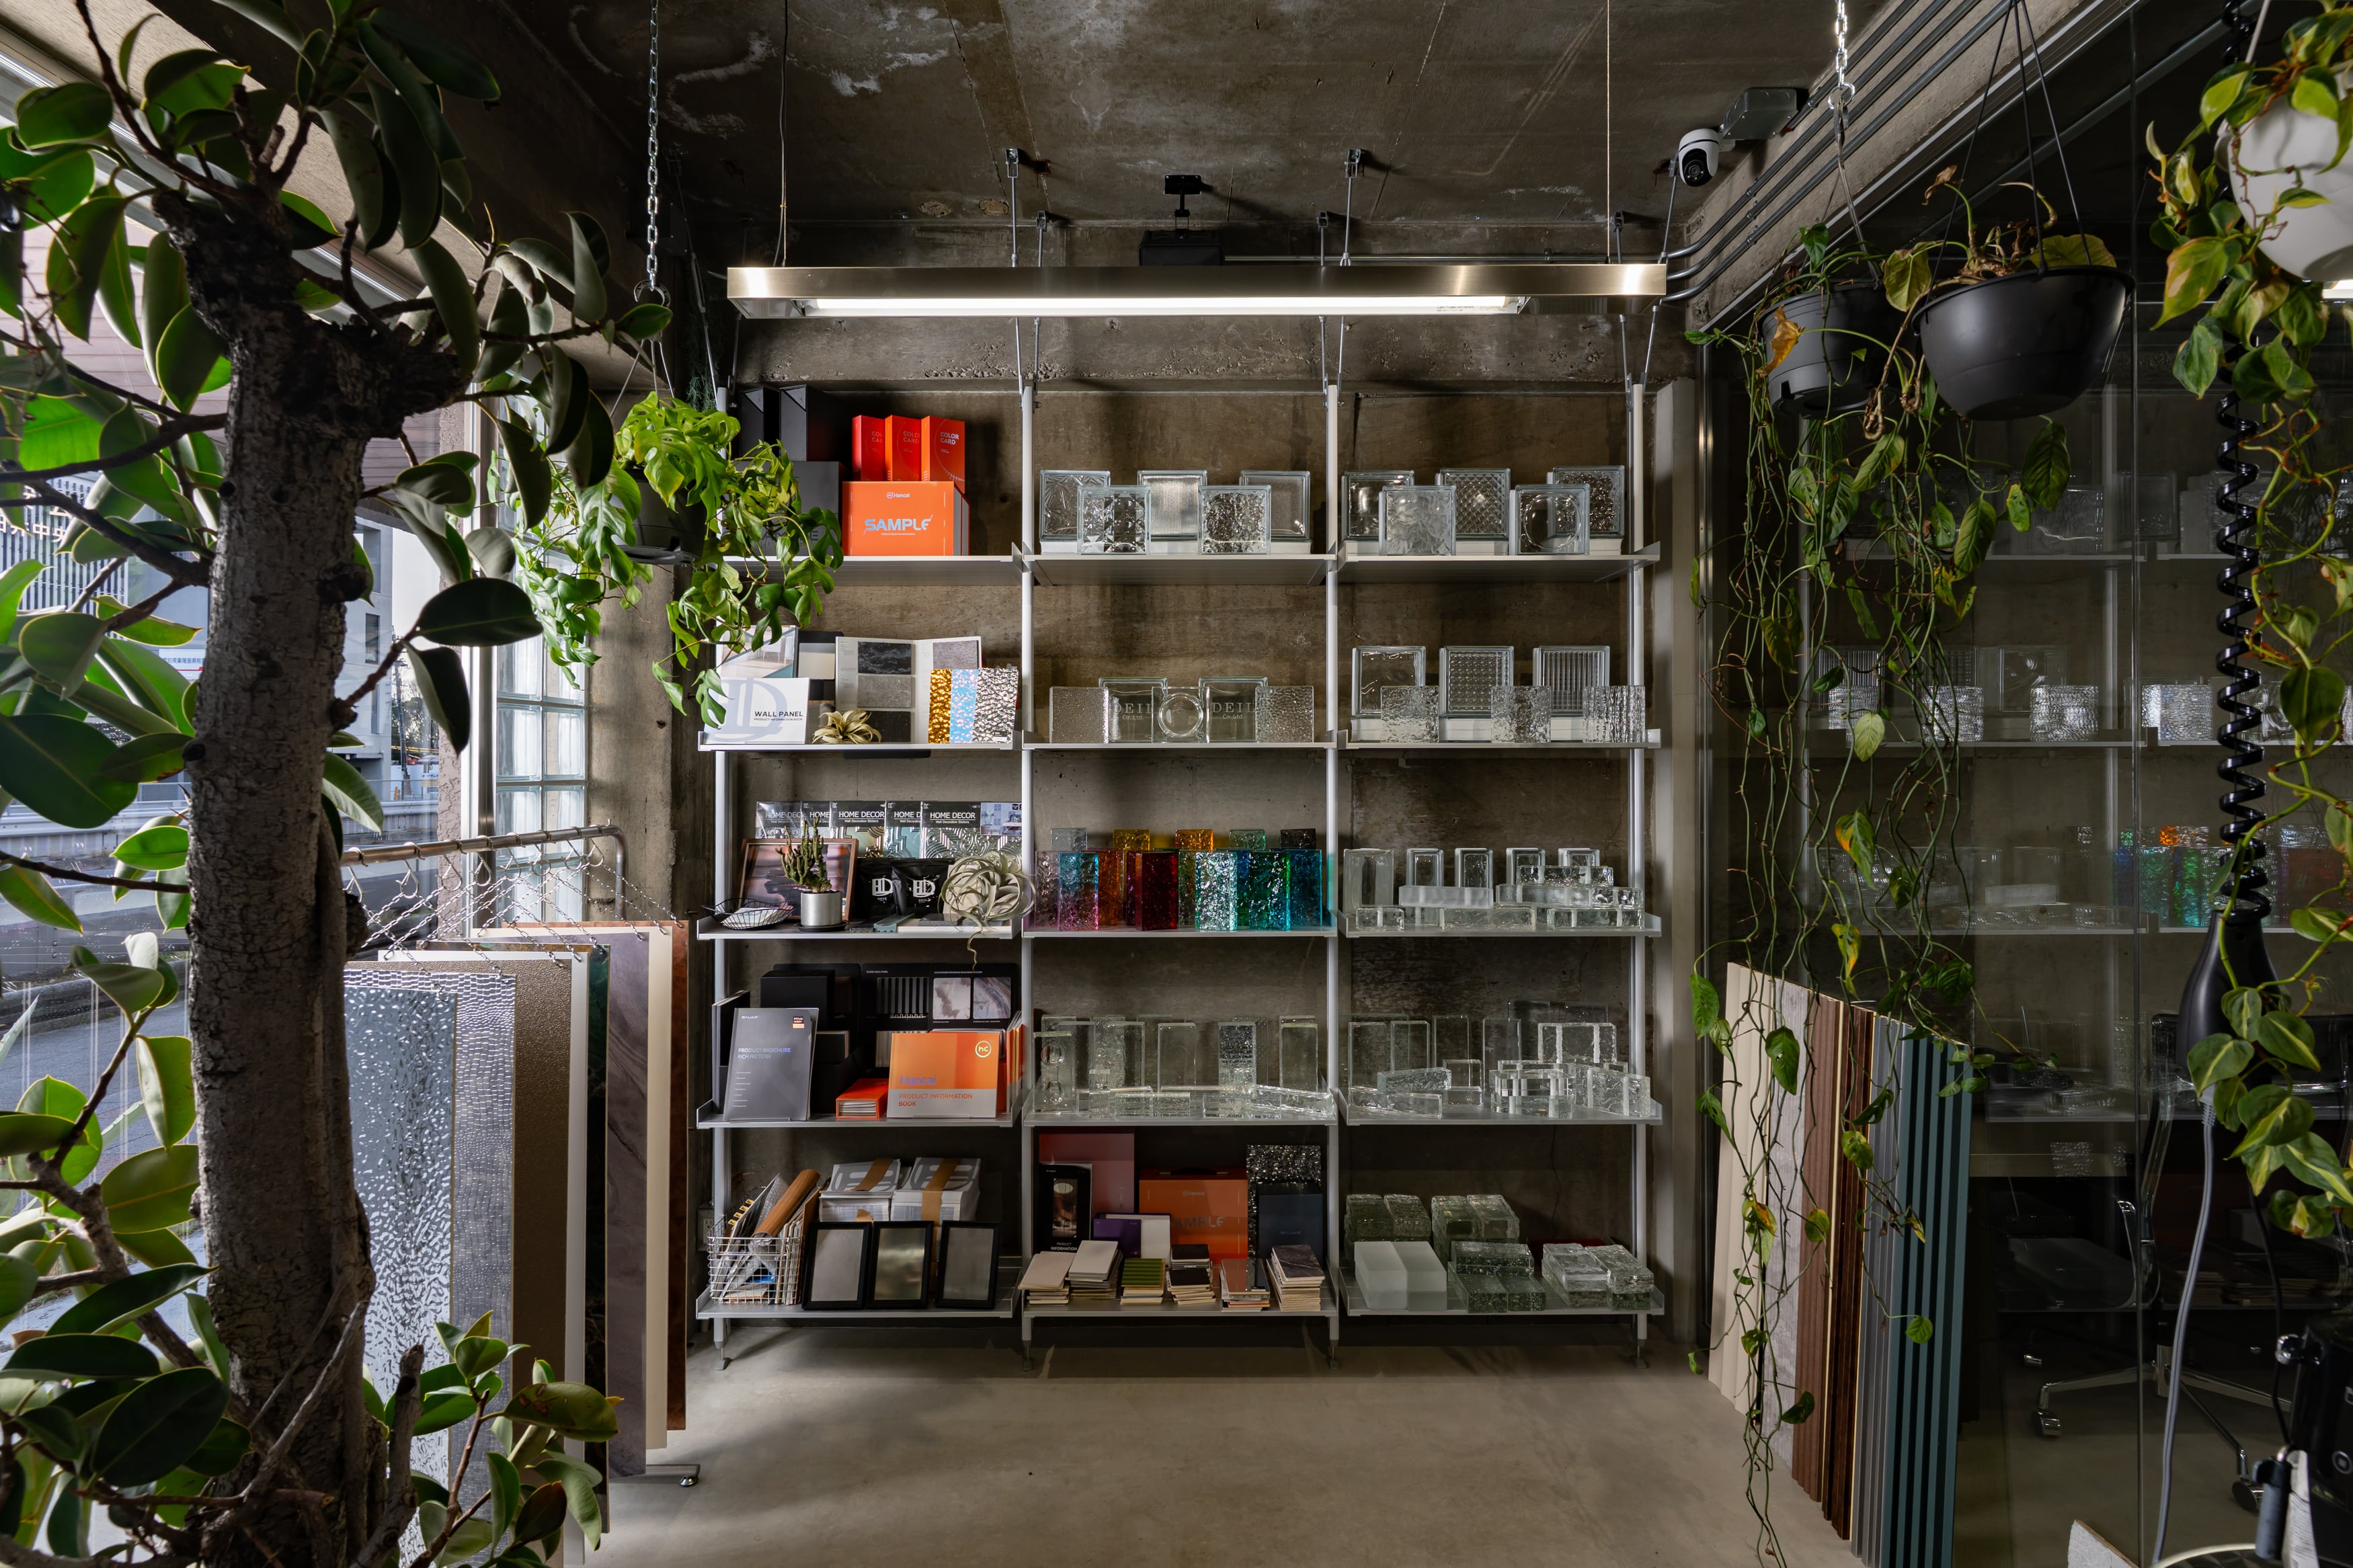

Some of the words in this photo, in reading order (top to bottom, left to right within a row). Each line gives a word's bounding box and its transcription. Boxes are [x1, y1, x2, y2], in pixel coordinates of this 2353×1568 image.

[940, 431, 959, 440] COLOR
[864, 517, 932, 532] SAMPLE
[900, 1075, 936, 1085] Hancai
